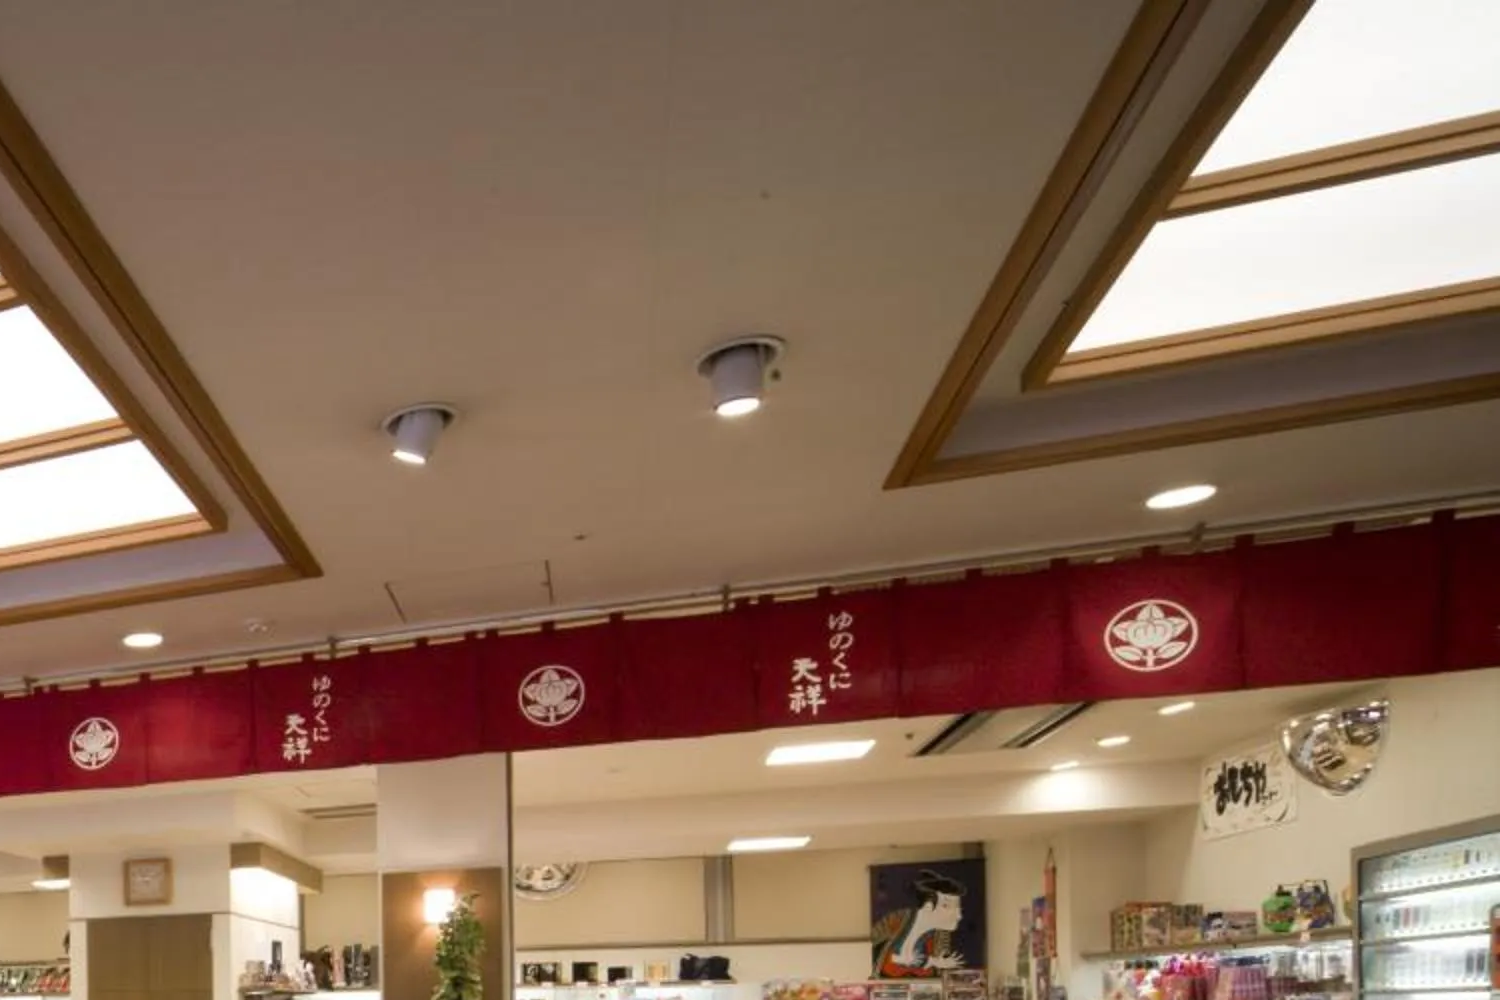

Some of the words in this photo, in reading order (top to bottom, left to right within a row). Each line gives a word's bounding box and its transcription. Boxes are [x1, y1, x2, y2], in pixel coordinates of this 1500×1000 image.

[829, 611, 853, 690] ゆのくに
[313, 675, 331, 741] ゆのくに
[788, 657, 826, 715] 天祥
[282, 714, 311, 763] 天祥
[1213, 761, 1266, 815] おもちゃ
